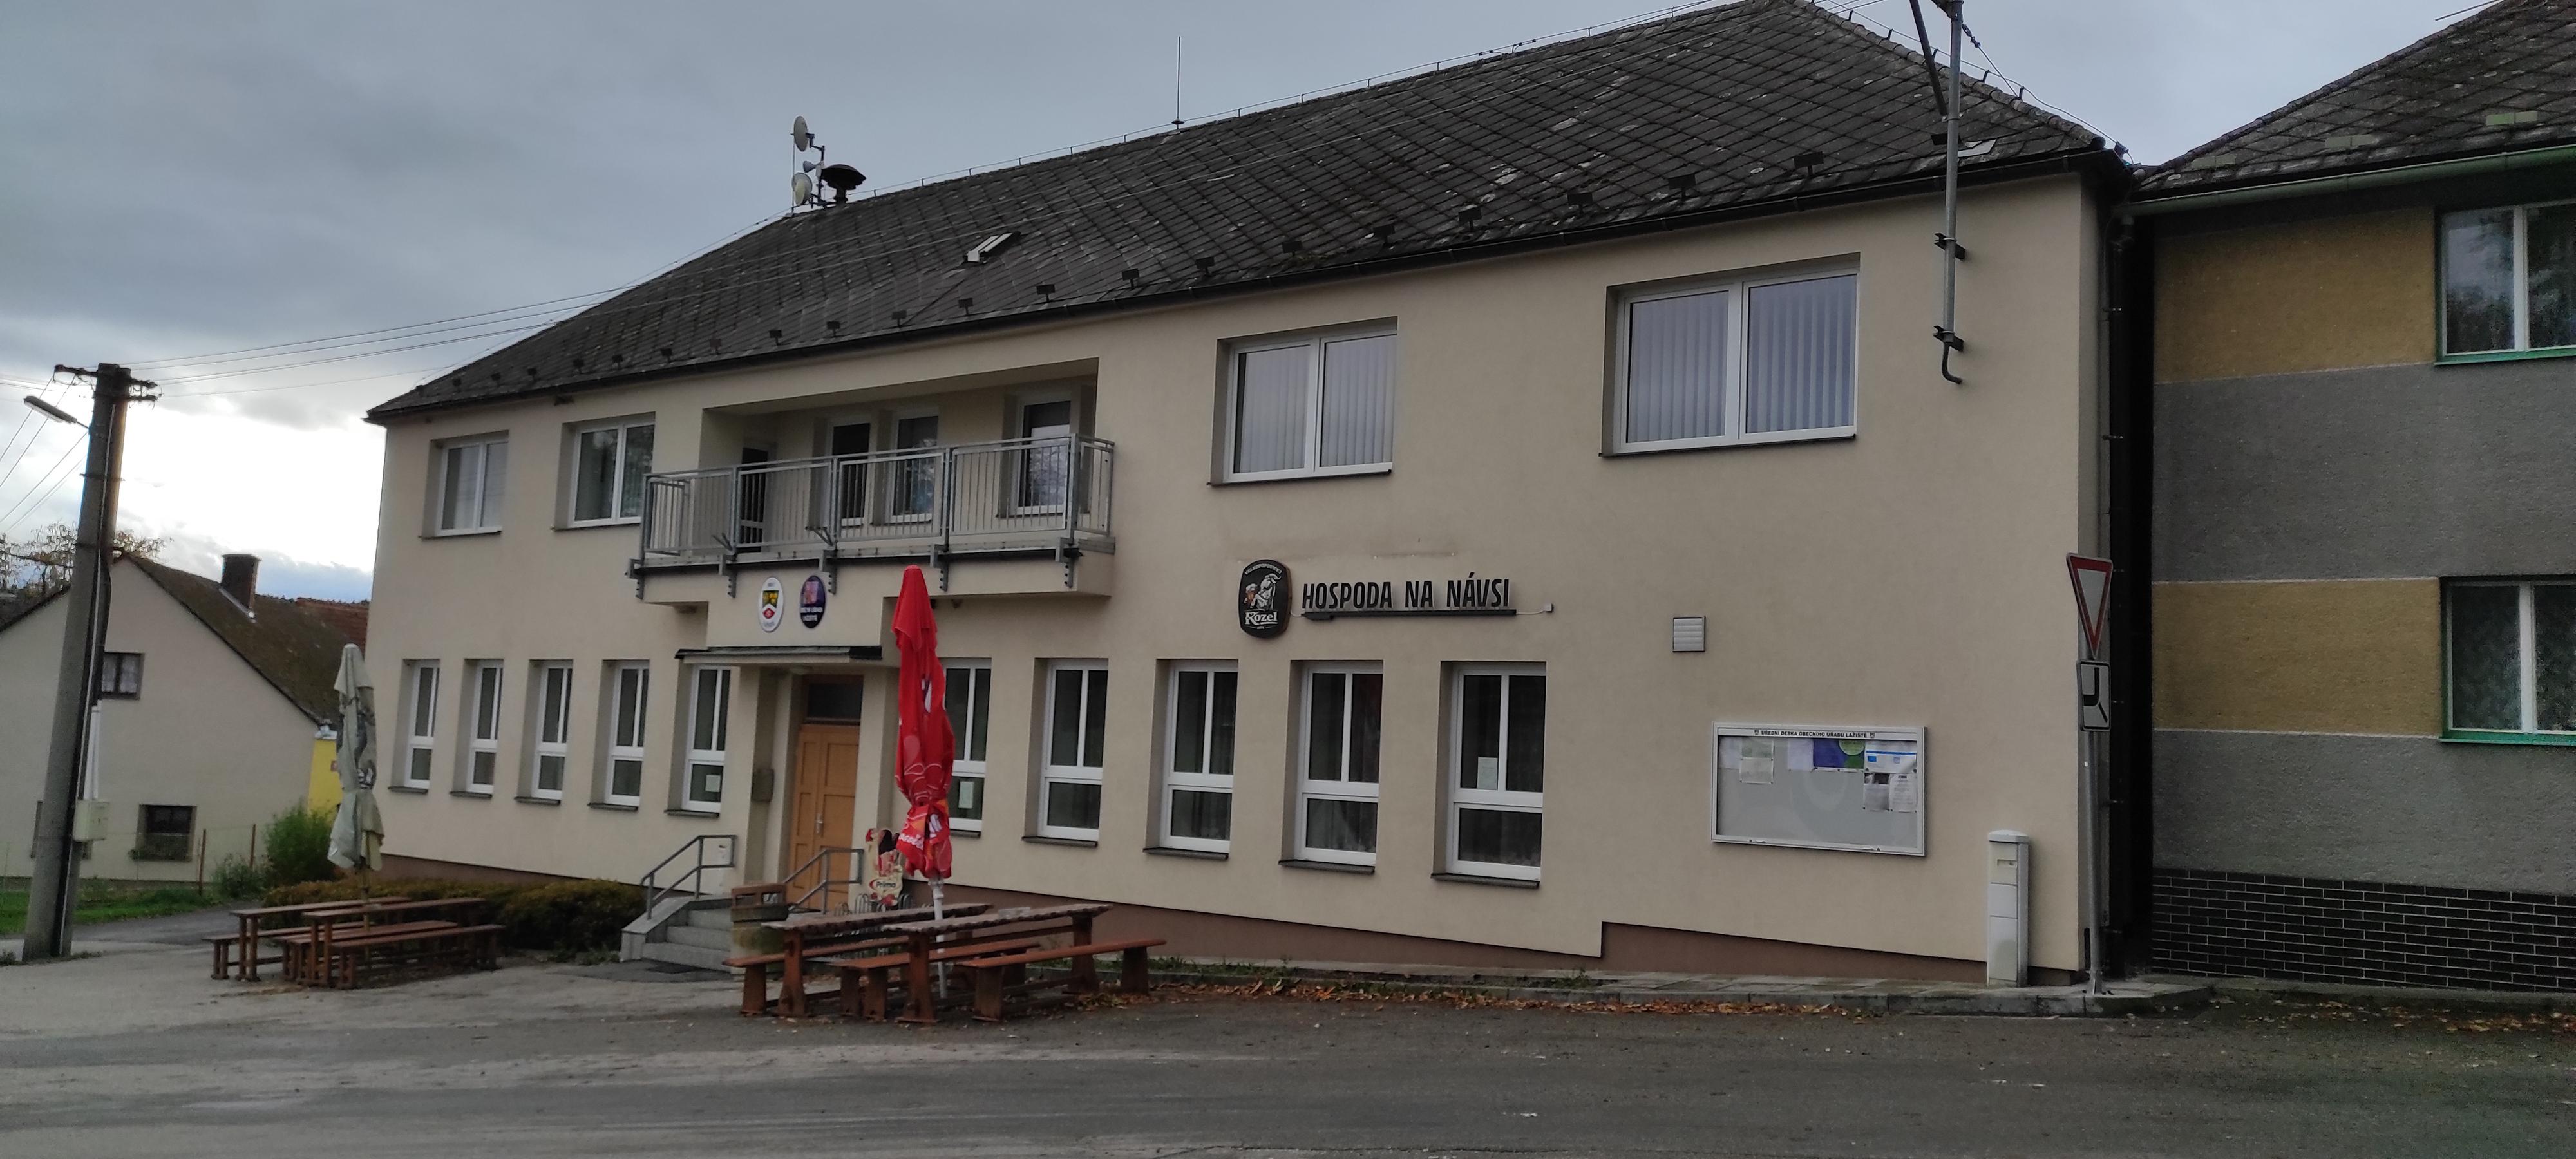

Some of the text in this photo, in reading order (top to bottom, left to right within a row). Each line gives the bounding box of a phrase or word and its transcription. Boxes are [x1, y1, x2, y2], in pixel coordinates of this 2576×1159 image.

[1302, 572, 1509, 608] HOSPODA NA NÁVSI
[1245, 612, 1277, 625] Kozel
